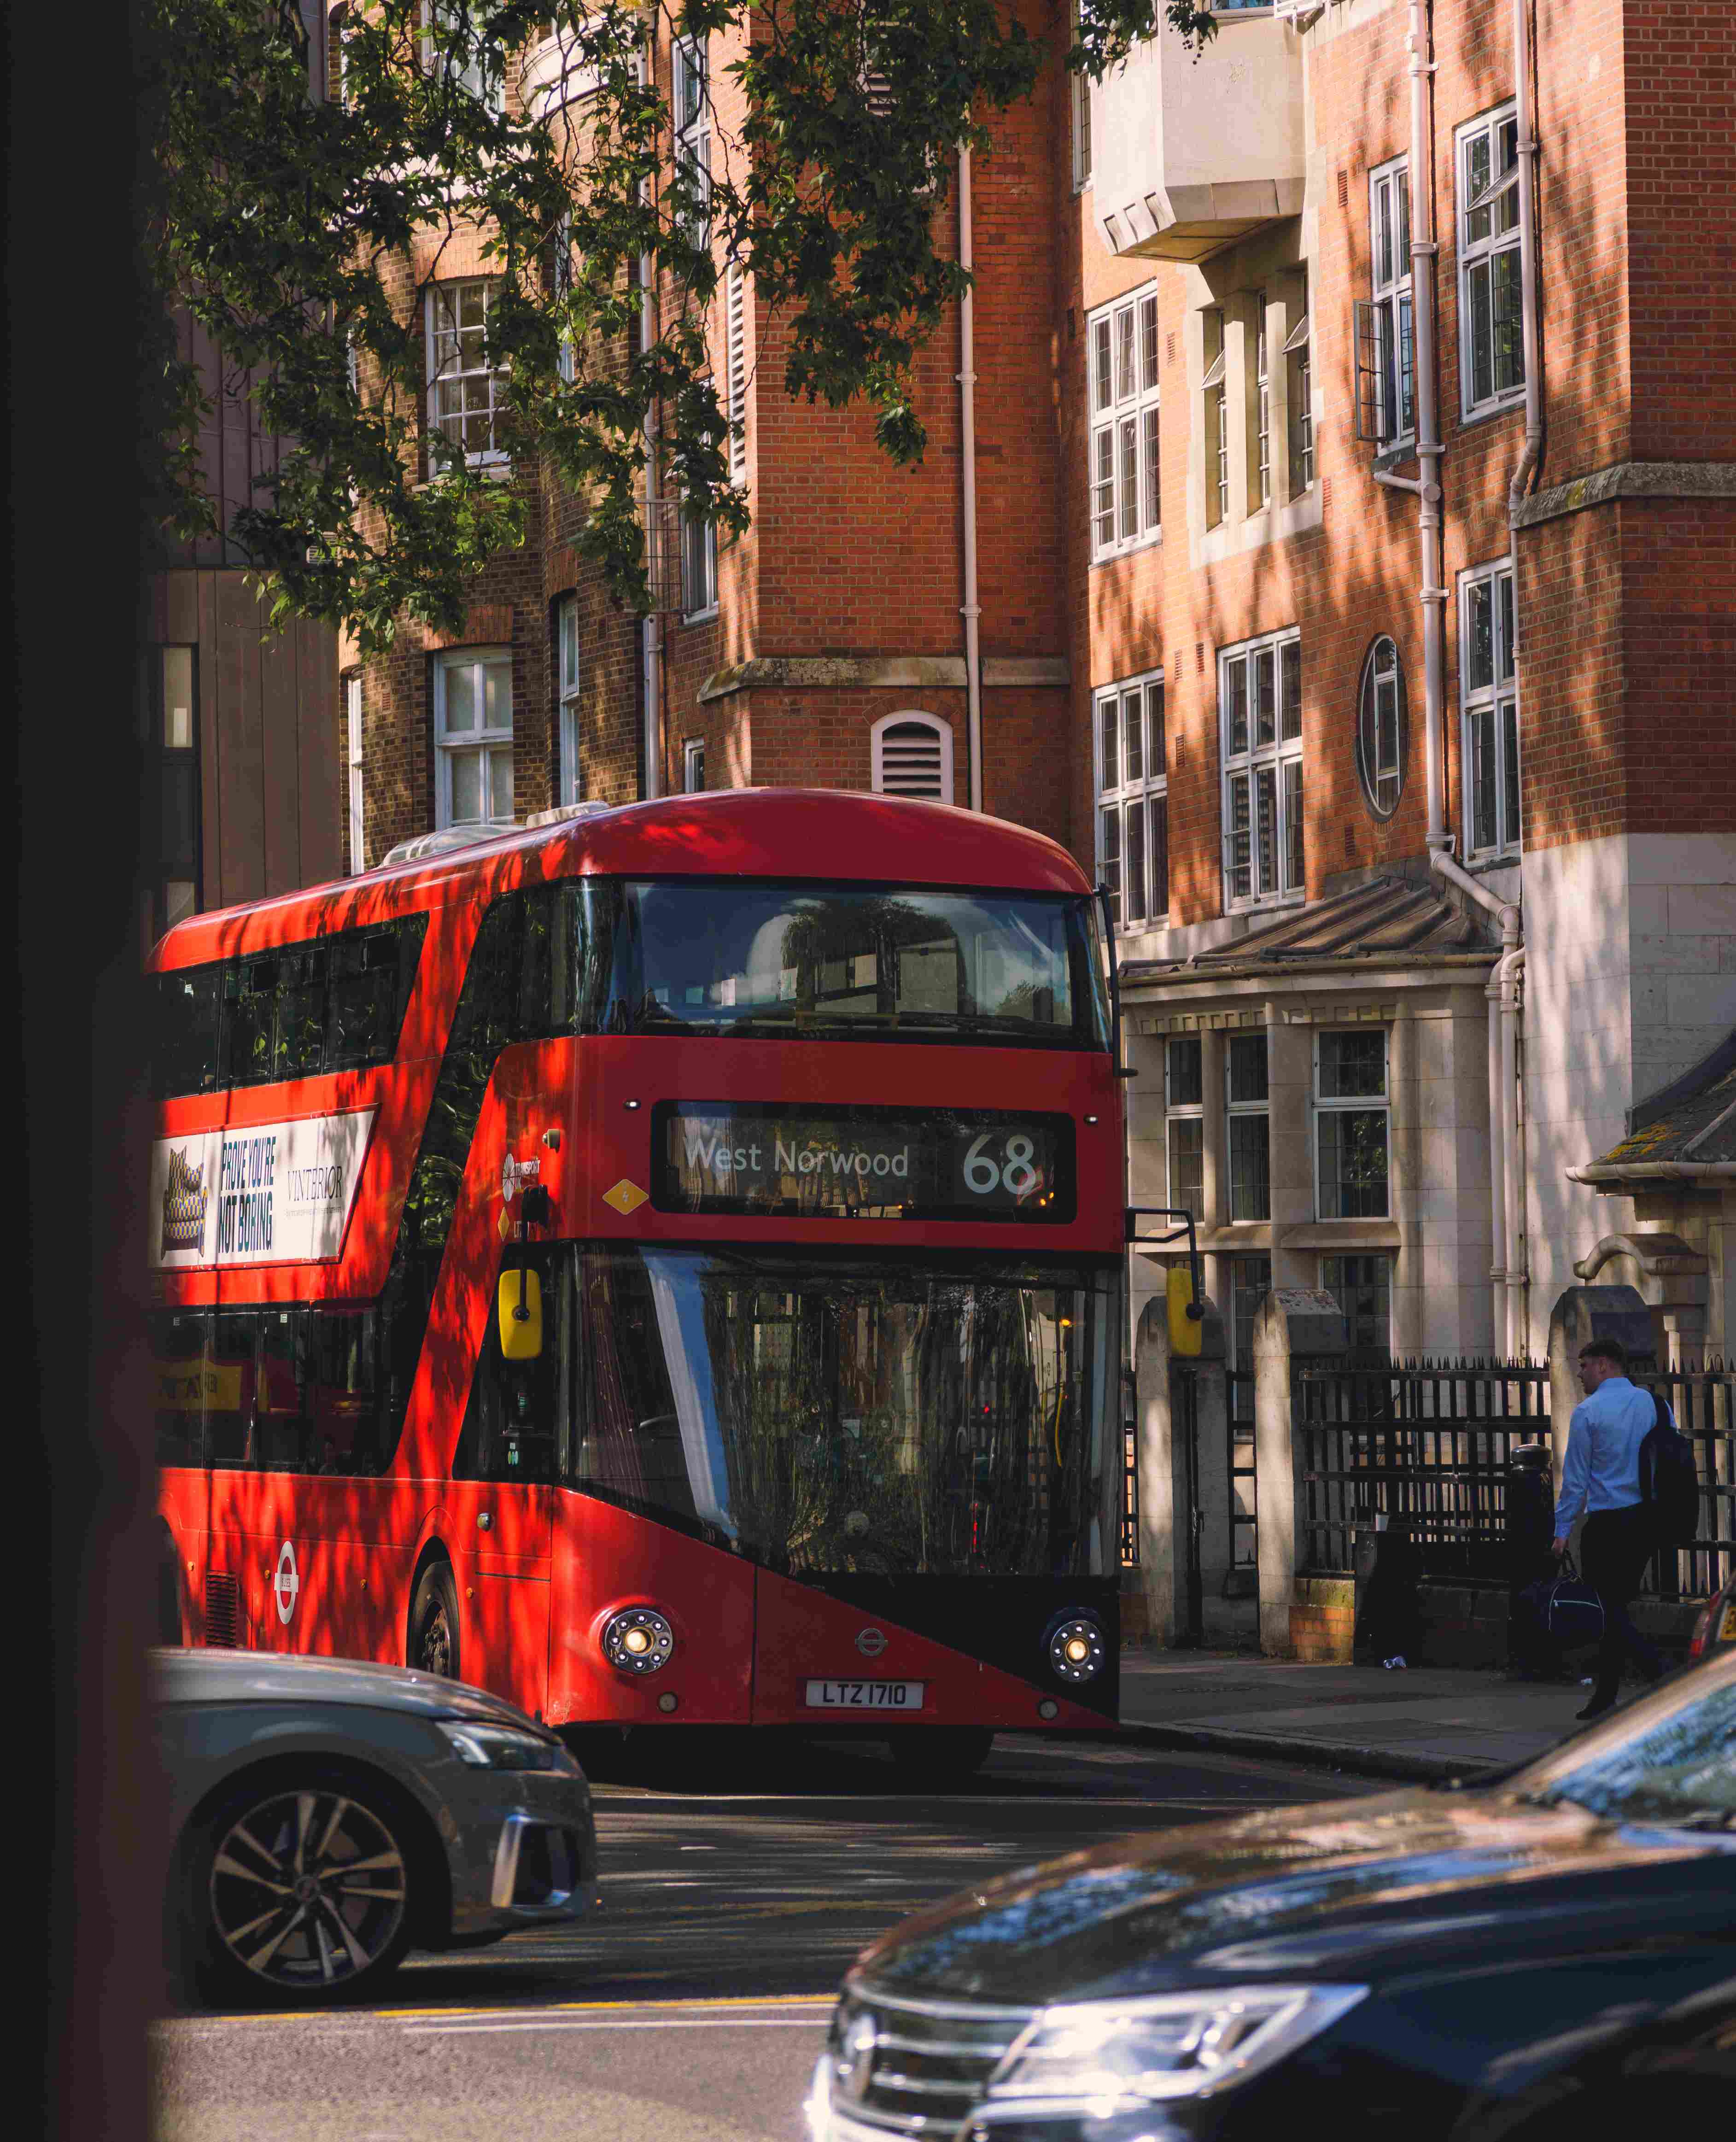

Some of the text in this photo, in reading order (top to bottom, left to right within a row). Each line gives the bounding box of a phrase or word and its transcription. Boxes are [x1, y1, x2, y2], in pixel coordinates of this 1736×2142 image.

[221, 1136, 276, 1191] PROVE YOU'RE
[288, 1165, 342, 1201] VINTERIOR
[515, 1160, 540, 1177] TRANSPORT
[684, 1134, 1036, 1194] West Norwood 68
[219, 1191, 273, 1253] NOT BORING
[823, 1684, 906, 1704] LTZ 1710
